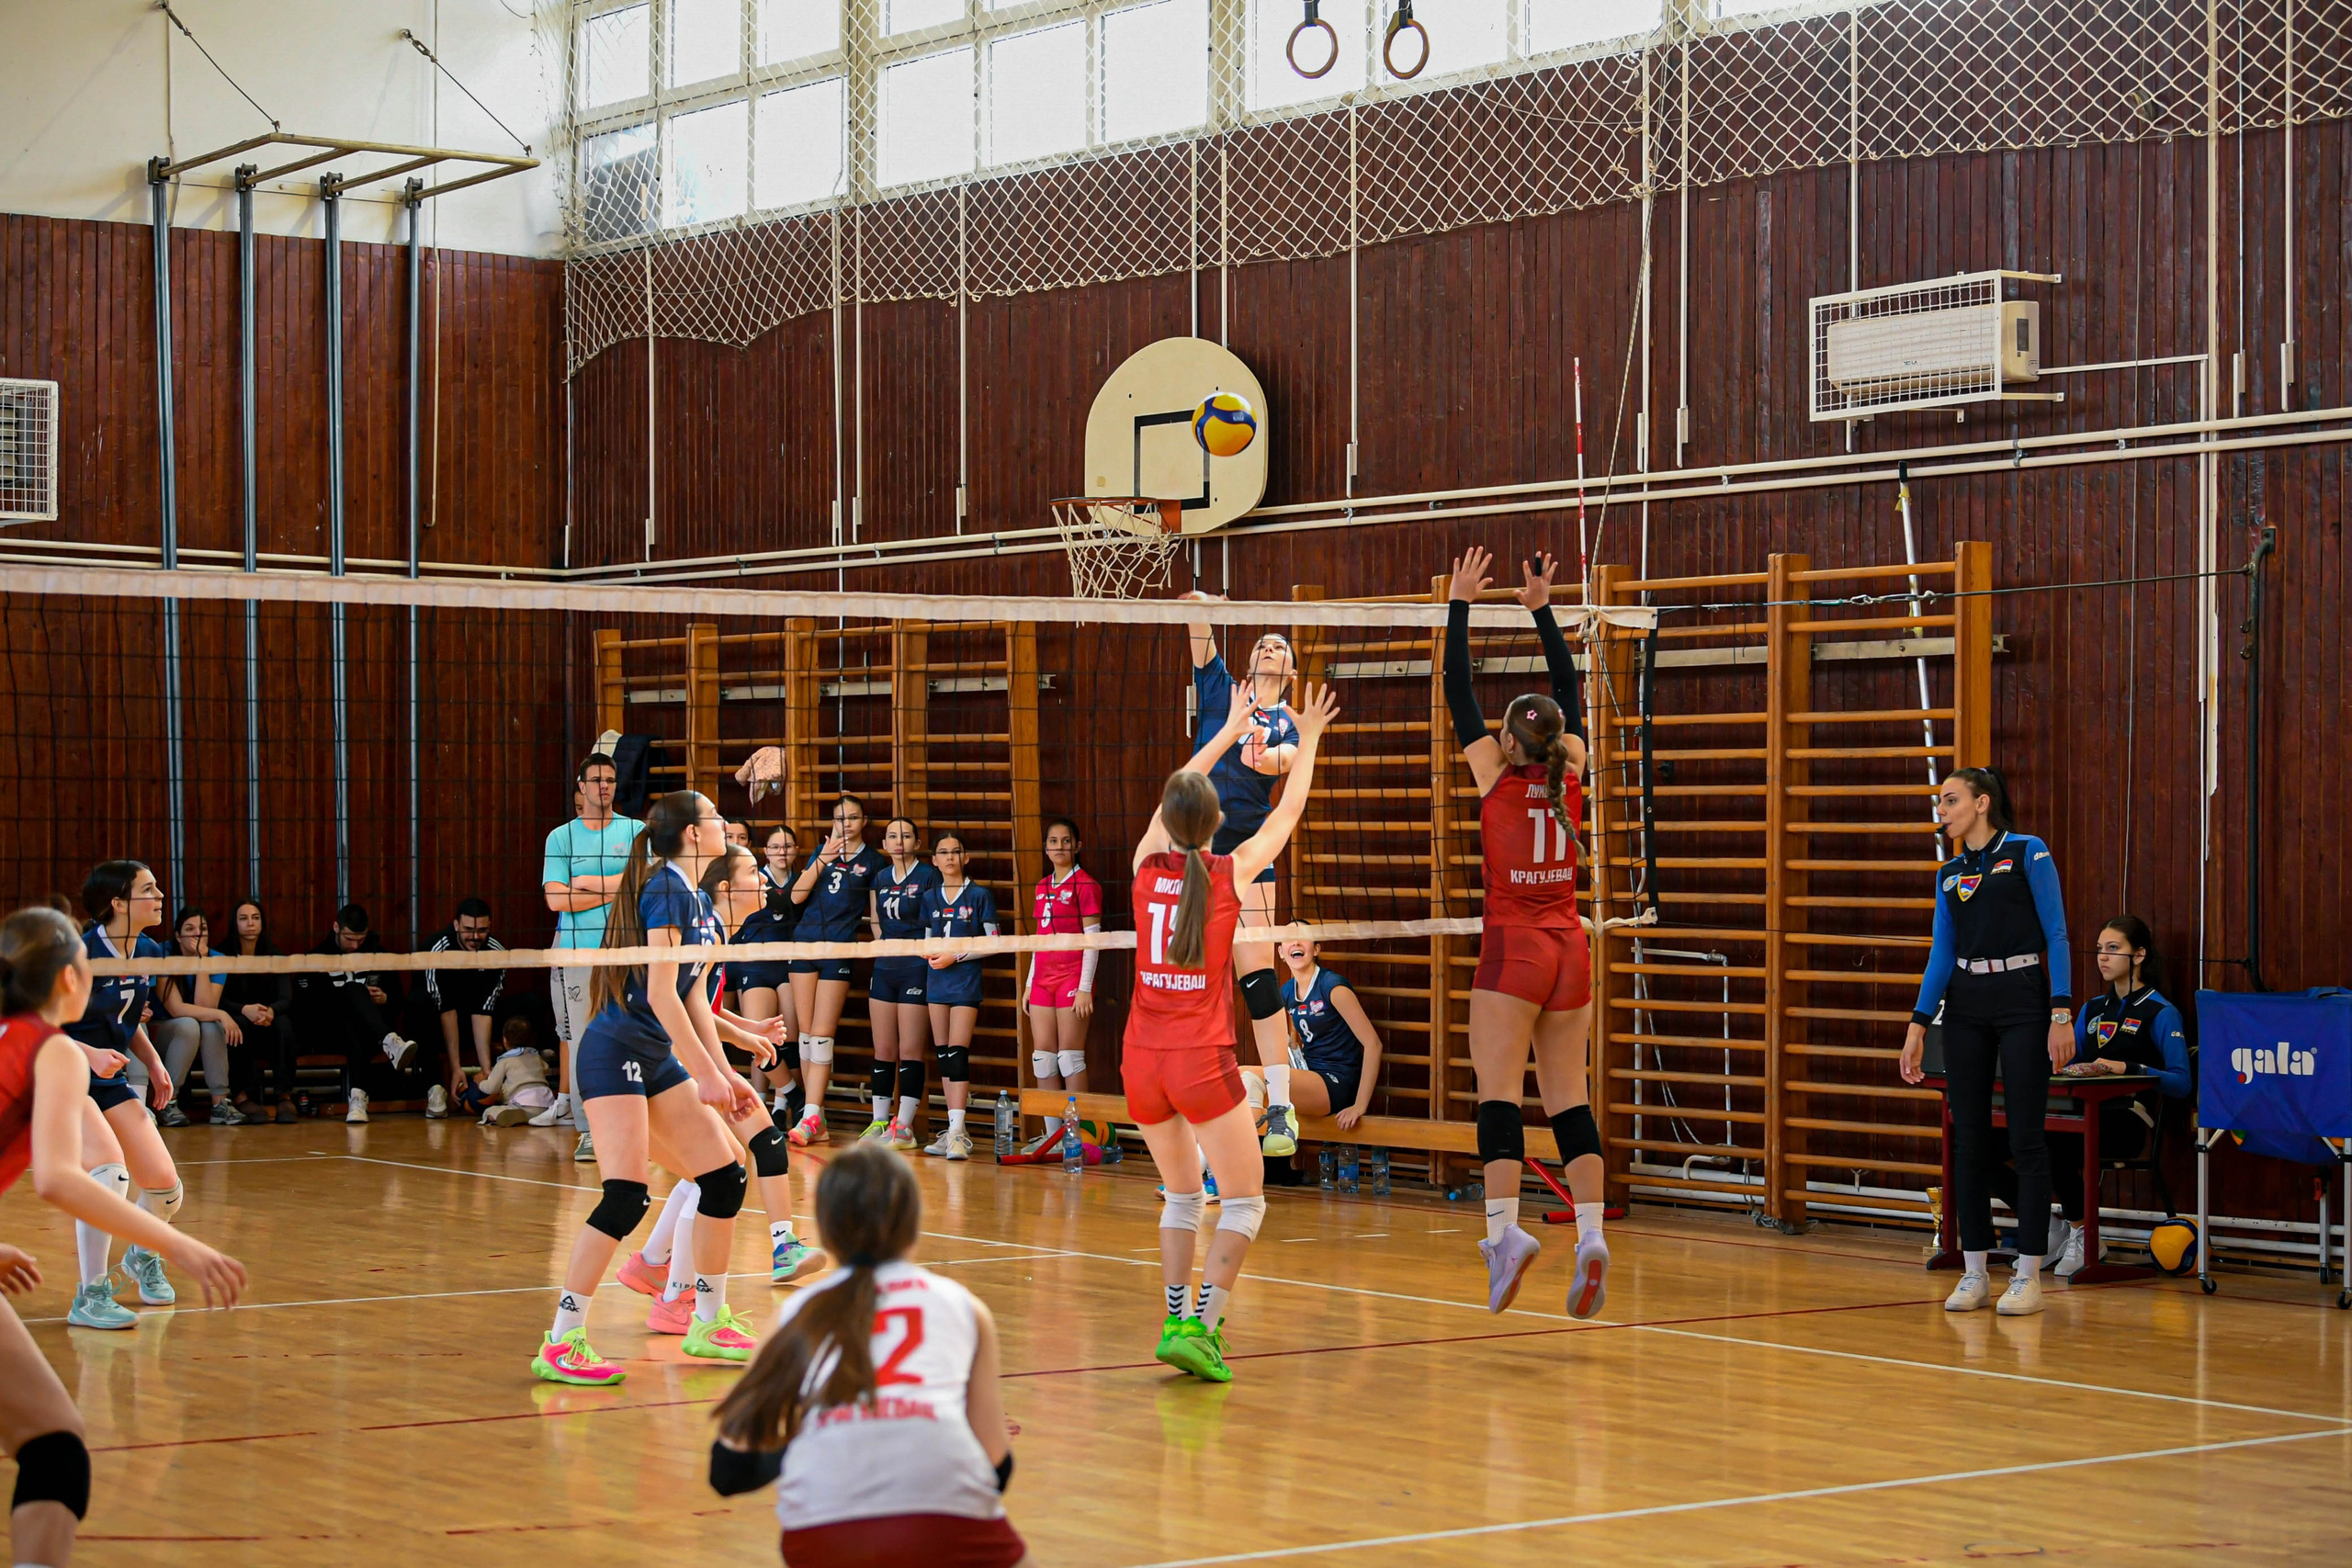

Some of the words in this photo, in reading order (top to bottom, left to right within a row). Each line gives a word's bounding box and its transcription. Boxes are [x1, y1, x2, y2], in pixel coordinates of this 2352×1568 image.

[1528, 808, 1566, 863] 11
[828, 871, 843, 894] 3
[1510, 867, 1574, 885] КРАГУЈЕВАЦ
[883, 897, 901, 919] 11
[1041, 902, 1053, 928] 5
[117, 988, 135, 1024] 7
[1931, 998, 1946, 1026] 2
[622, 1061, 643, 1083] 12
[2231, 1043, 2314, 1084] gala
